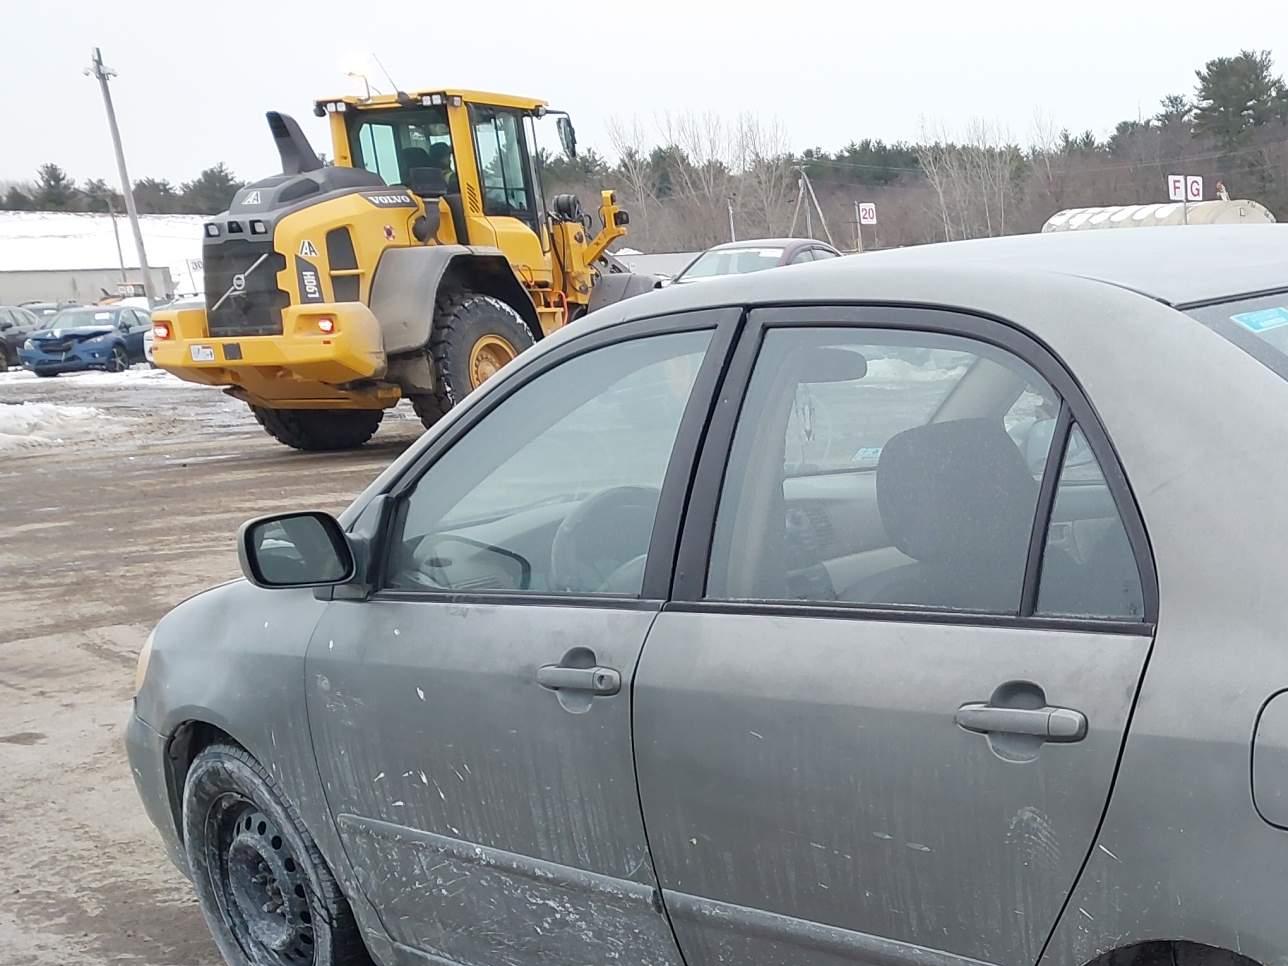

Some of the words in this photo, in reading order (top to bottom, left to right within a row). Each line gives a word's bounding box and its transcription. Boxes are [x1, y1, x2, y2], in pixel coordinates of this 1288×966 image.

[1172, 179, 1181, 196] F
[1190, 180, 1200, 197] G
[367, 195, 410, 204] VOLVO
[861, 207, 874, 220] 20
[302, 271, 320, 298] L90H
